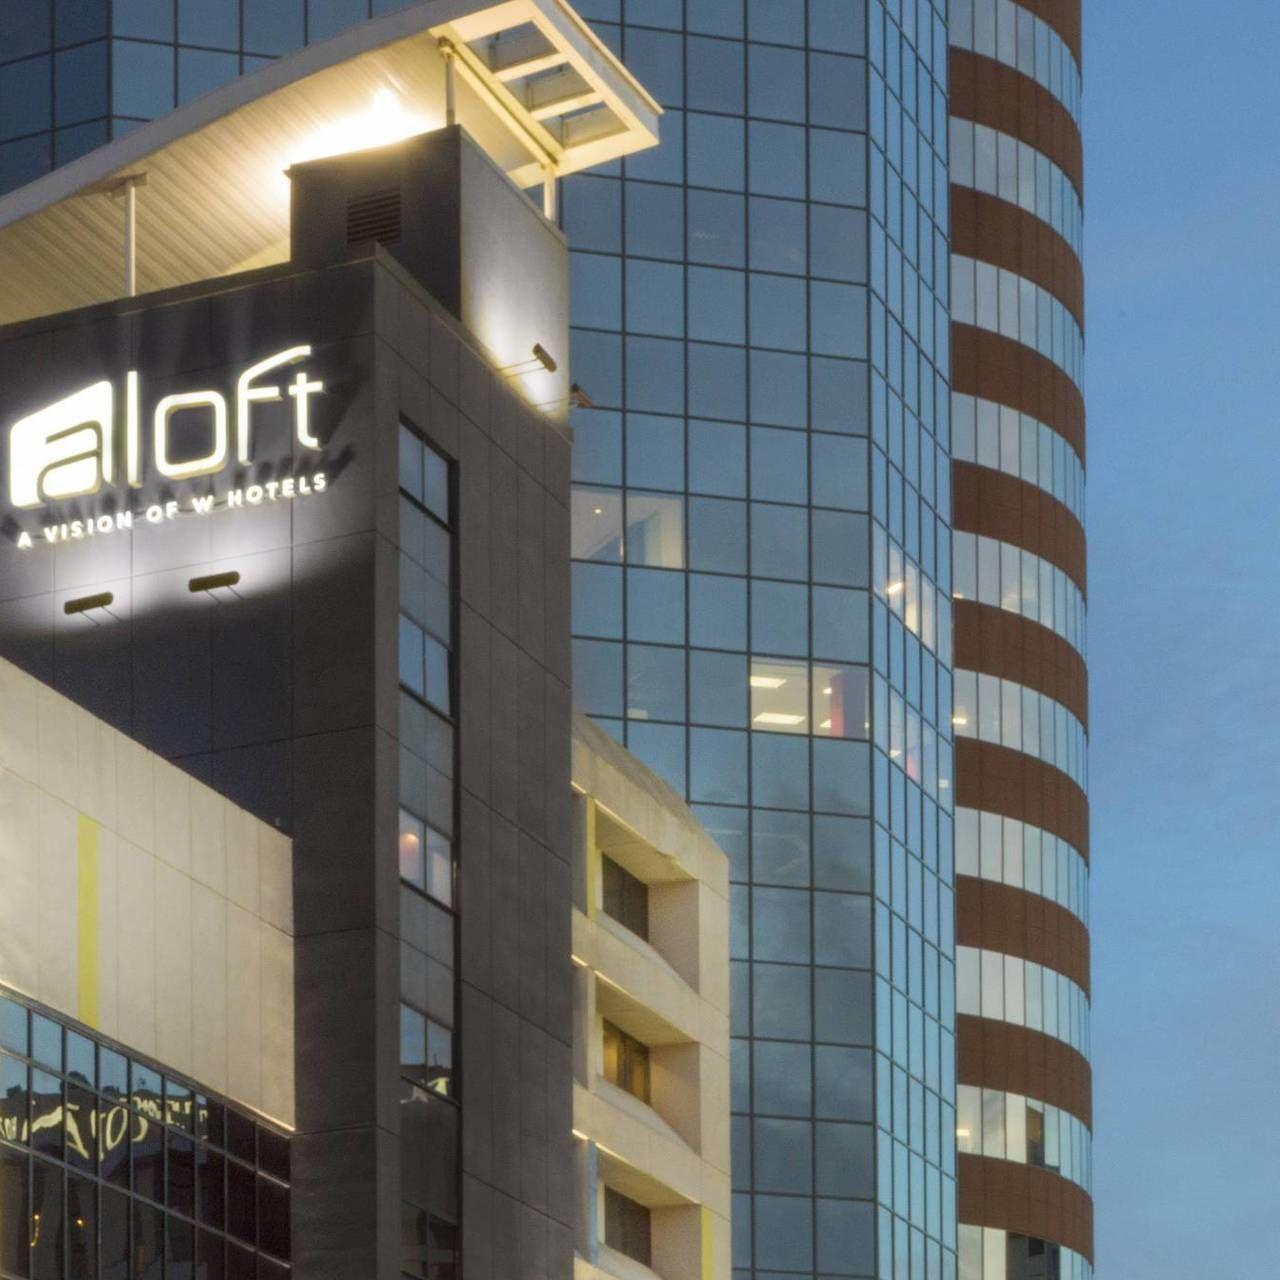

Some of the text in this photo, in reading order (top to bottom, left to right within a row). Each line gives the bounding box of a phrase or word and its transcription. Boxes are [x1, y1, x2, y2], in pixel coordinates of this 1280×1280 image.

[9, 344, 324, 508] aloft
[16, 472, 327, 549] A VISION OF W HOTELS
